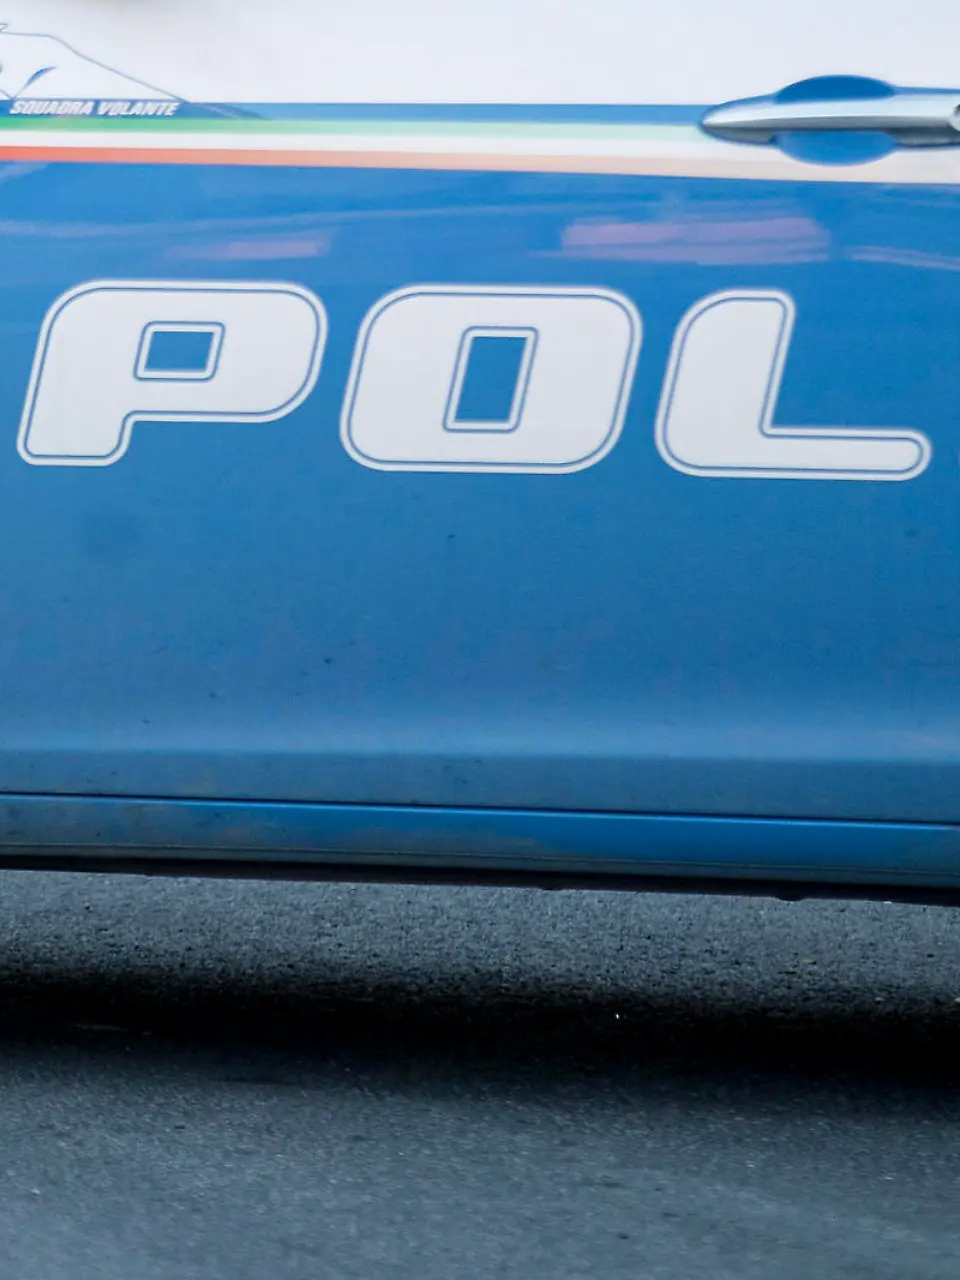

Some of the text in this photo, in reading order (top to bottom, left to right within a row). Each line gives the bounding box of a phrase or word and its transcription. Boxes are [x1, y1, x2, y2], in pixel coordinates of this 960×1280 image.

[9, 101, 180, 116] SQUADRA VOLANTE
[16, 279, 932, 481] POL
